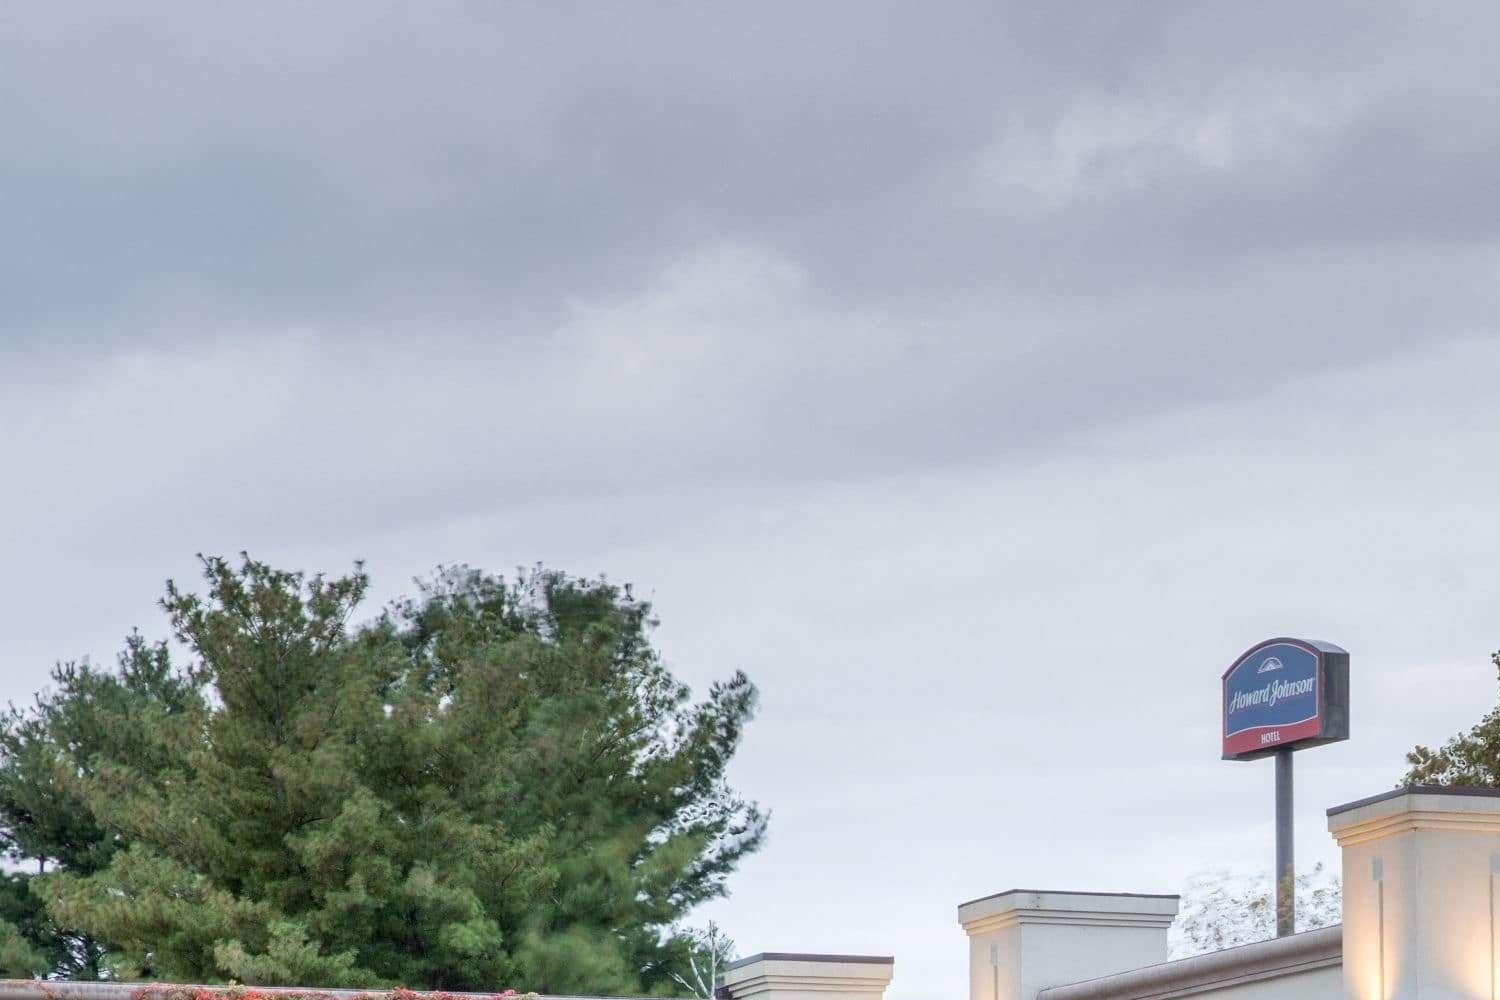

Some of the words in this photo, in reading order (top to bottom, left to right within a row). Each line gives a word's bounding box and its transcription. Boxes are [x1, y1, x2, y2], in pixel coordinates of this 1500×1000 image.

[1229, 684, 1270, 714] Howard
[1269, 679, 1315, 706] Johnson
[1261, 731, 1281, 744] HOTEL
